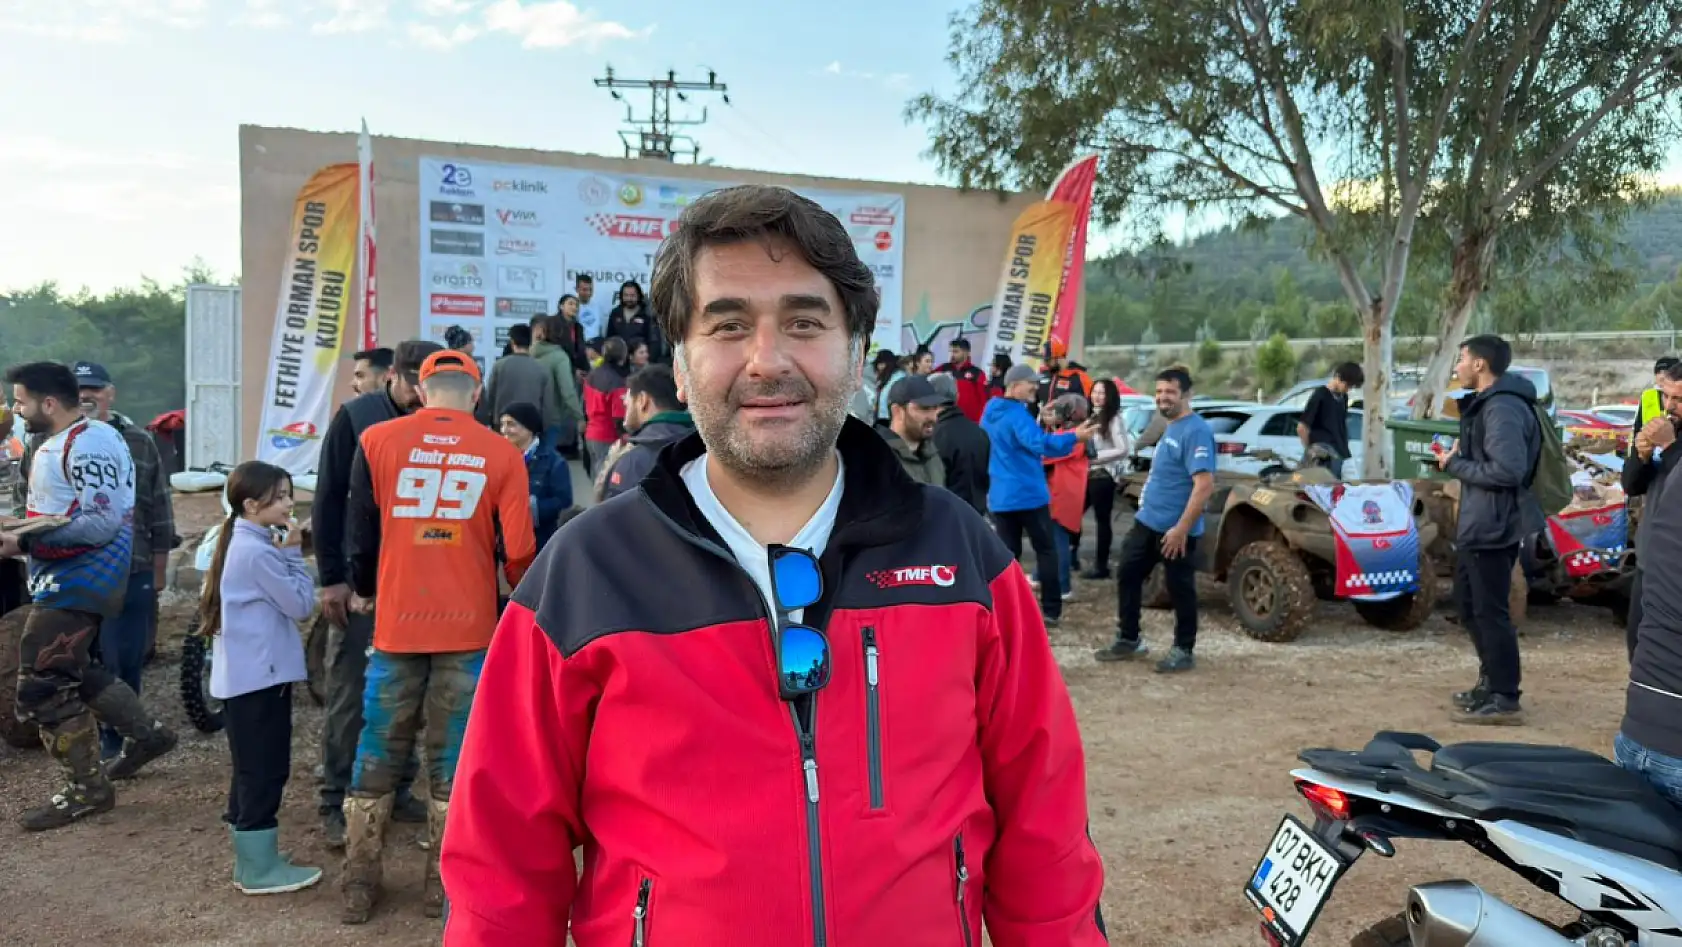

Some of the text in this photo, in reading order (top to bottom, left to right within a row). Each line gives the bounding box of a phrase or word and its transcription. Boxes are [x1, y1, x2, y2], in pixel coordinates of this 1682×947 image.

[618, 220, 660, 235] TMF
[1011, 233, 1037, 280] SPOR
[274, 200, 326, 409] FETHİYE ORMAN SPOR
[315, 270, 346, 349] KULÜBÜ
[996, 282, 1027, 343] ORMAN
[1022, 292, 1052, 360] KULÜBÜ
[72, 460, 119, 492] 899
[392, 467, 488, 520] 99
[894, 567, 930, 582] TMF
[1275, 826, 1334, 894] 07 BKH
[1269, 870, 1301, 913] 428
